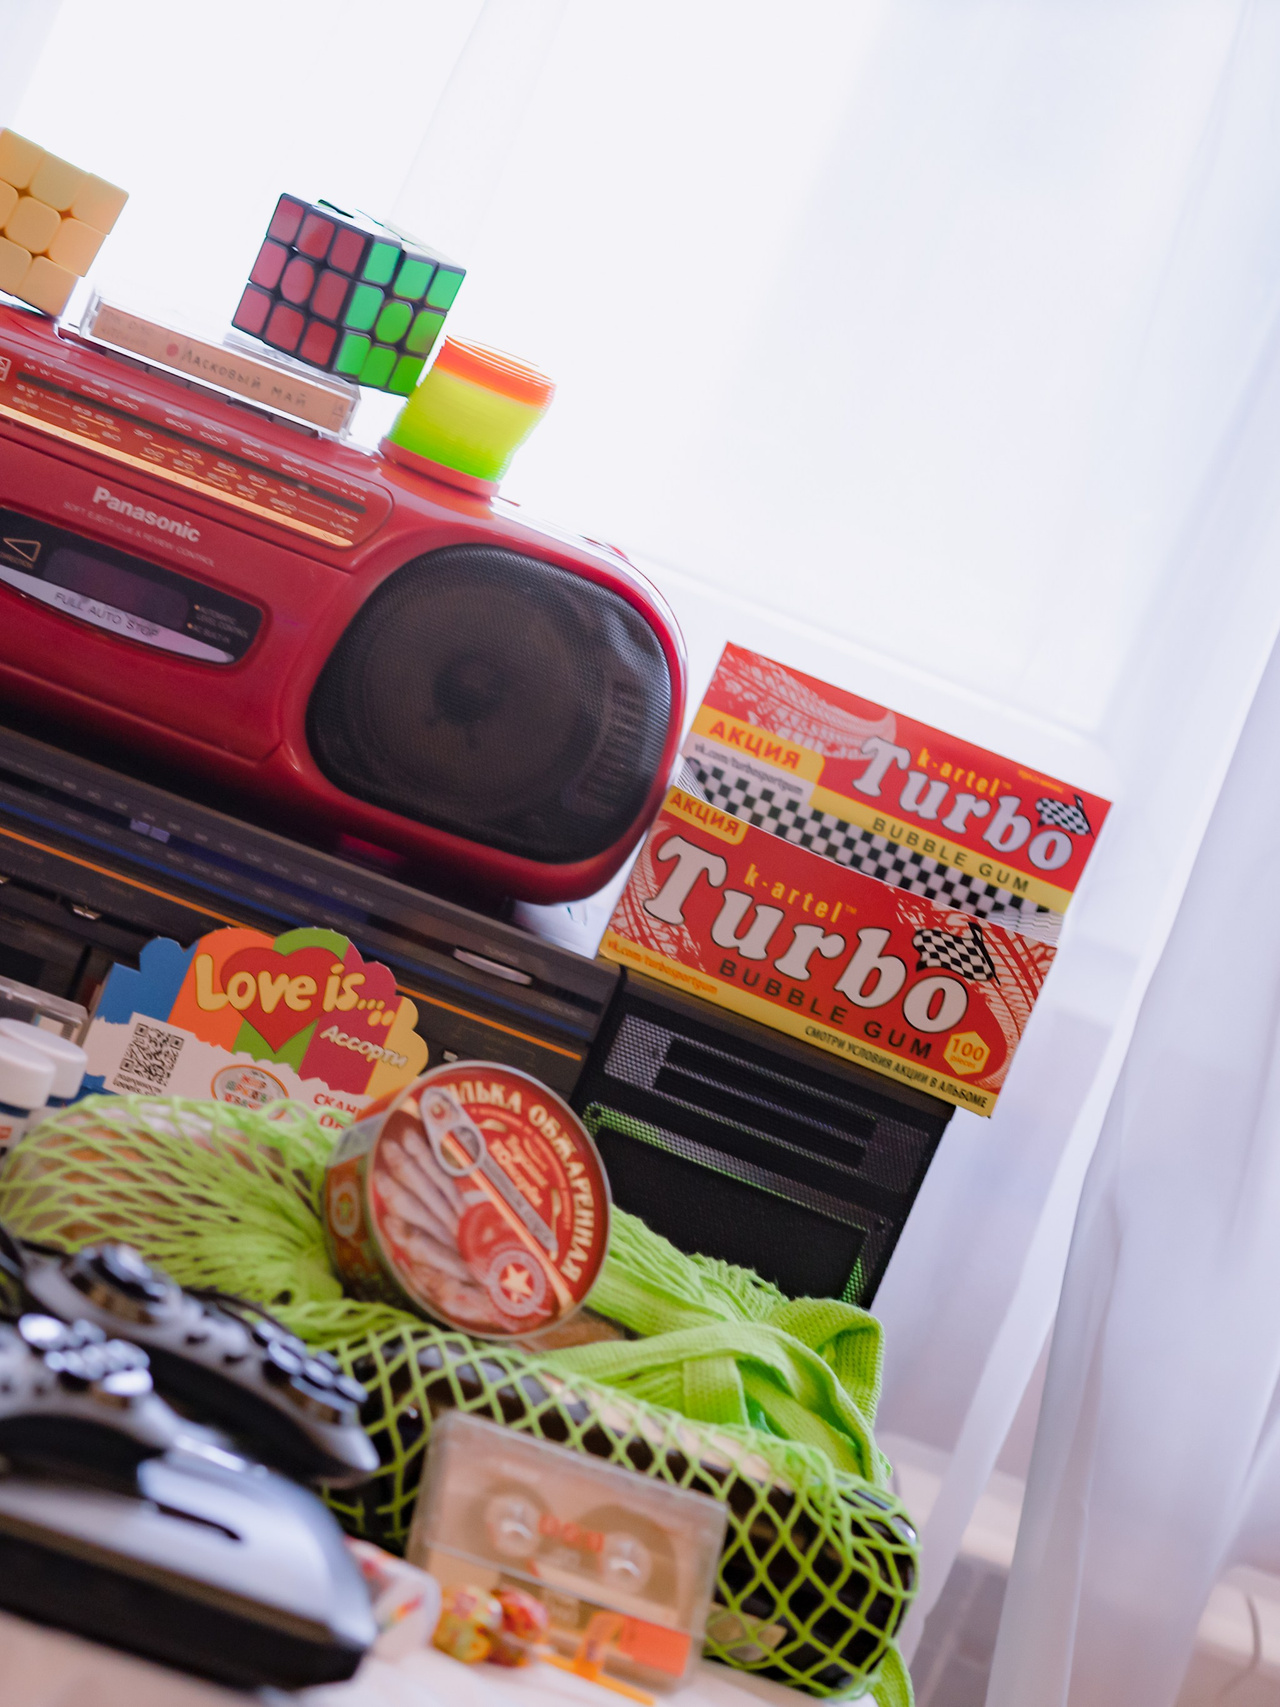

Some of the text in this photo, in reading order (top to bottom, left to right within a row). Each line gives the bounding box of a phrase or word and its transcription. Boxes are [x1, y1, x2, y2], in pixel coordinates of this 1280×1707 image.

[92, 485, 200, 544] Panasonic
[53, 590, 162, 642] FULL AUTO STOP
[708, 721, 800, 770] АКЦИЯ
[669, 791, 741, 840] АКЦИЯ
[851, 736, 1073, 871] Turbo
[872, 817, 1030, 892] BUBBLE GUM
[643, 836, 968, 1033] Turbo
[195, 953, 320, 1013] Love
[719, 959, 933, 1060] BUBBLE GUM
[319, 1025, 409, 1069] Ассорти
[804, 1025, 989, 1110] СМОТРИ УСЛОВИЯ АКЦИИ В АЛЬБОМЕ
[950, 1036, 985, 1063] 100
